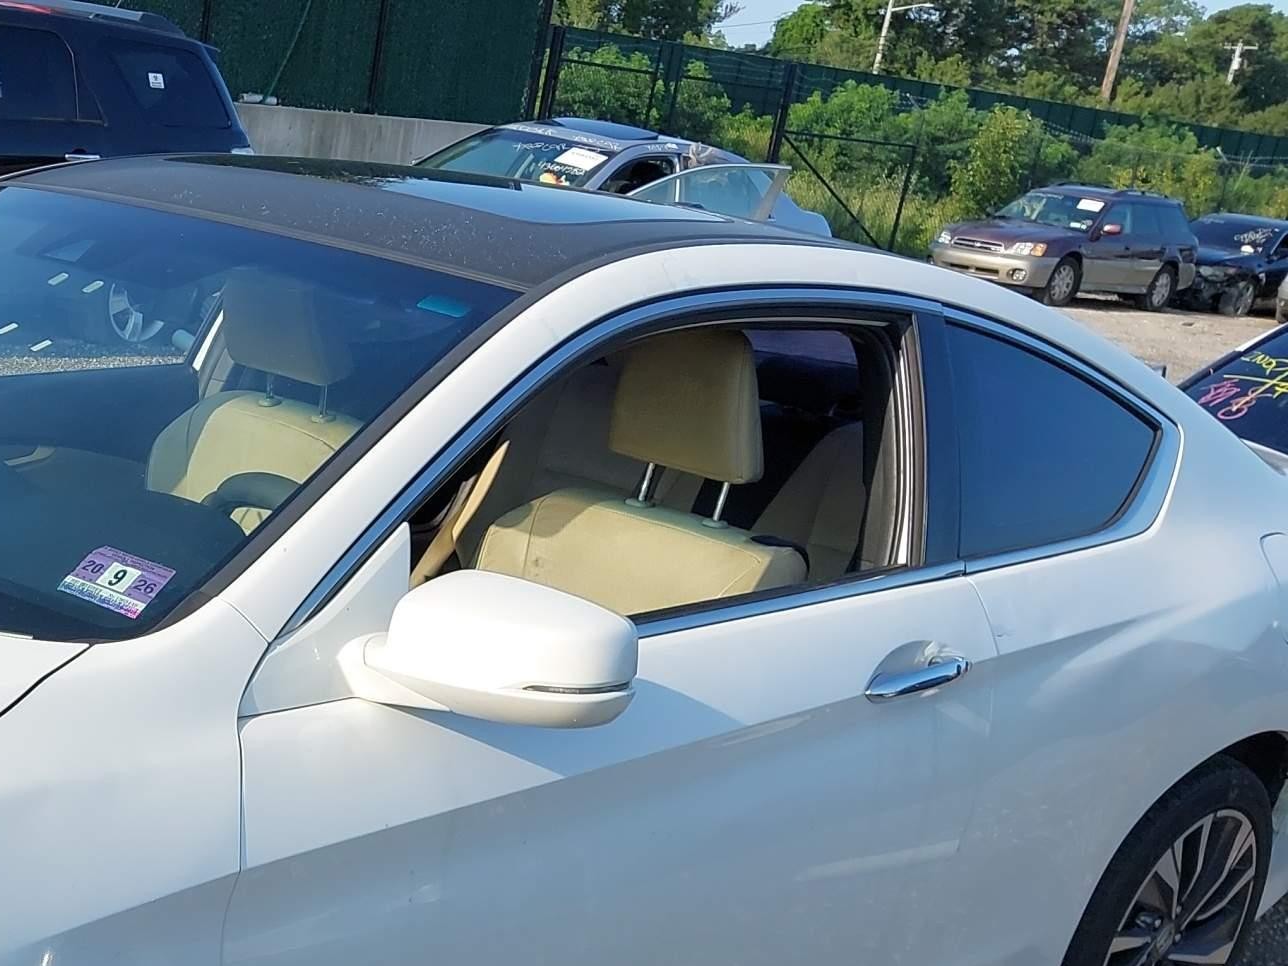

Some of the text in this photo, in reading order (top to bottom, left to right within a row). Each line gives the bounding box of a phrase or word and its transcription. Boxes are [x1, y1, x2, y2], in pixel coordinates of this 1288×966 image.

[81, 560, 105, 574] 20
[108, 569, 128, 586] 9
[133, 579, 157, 595] 26
